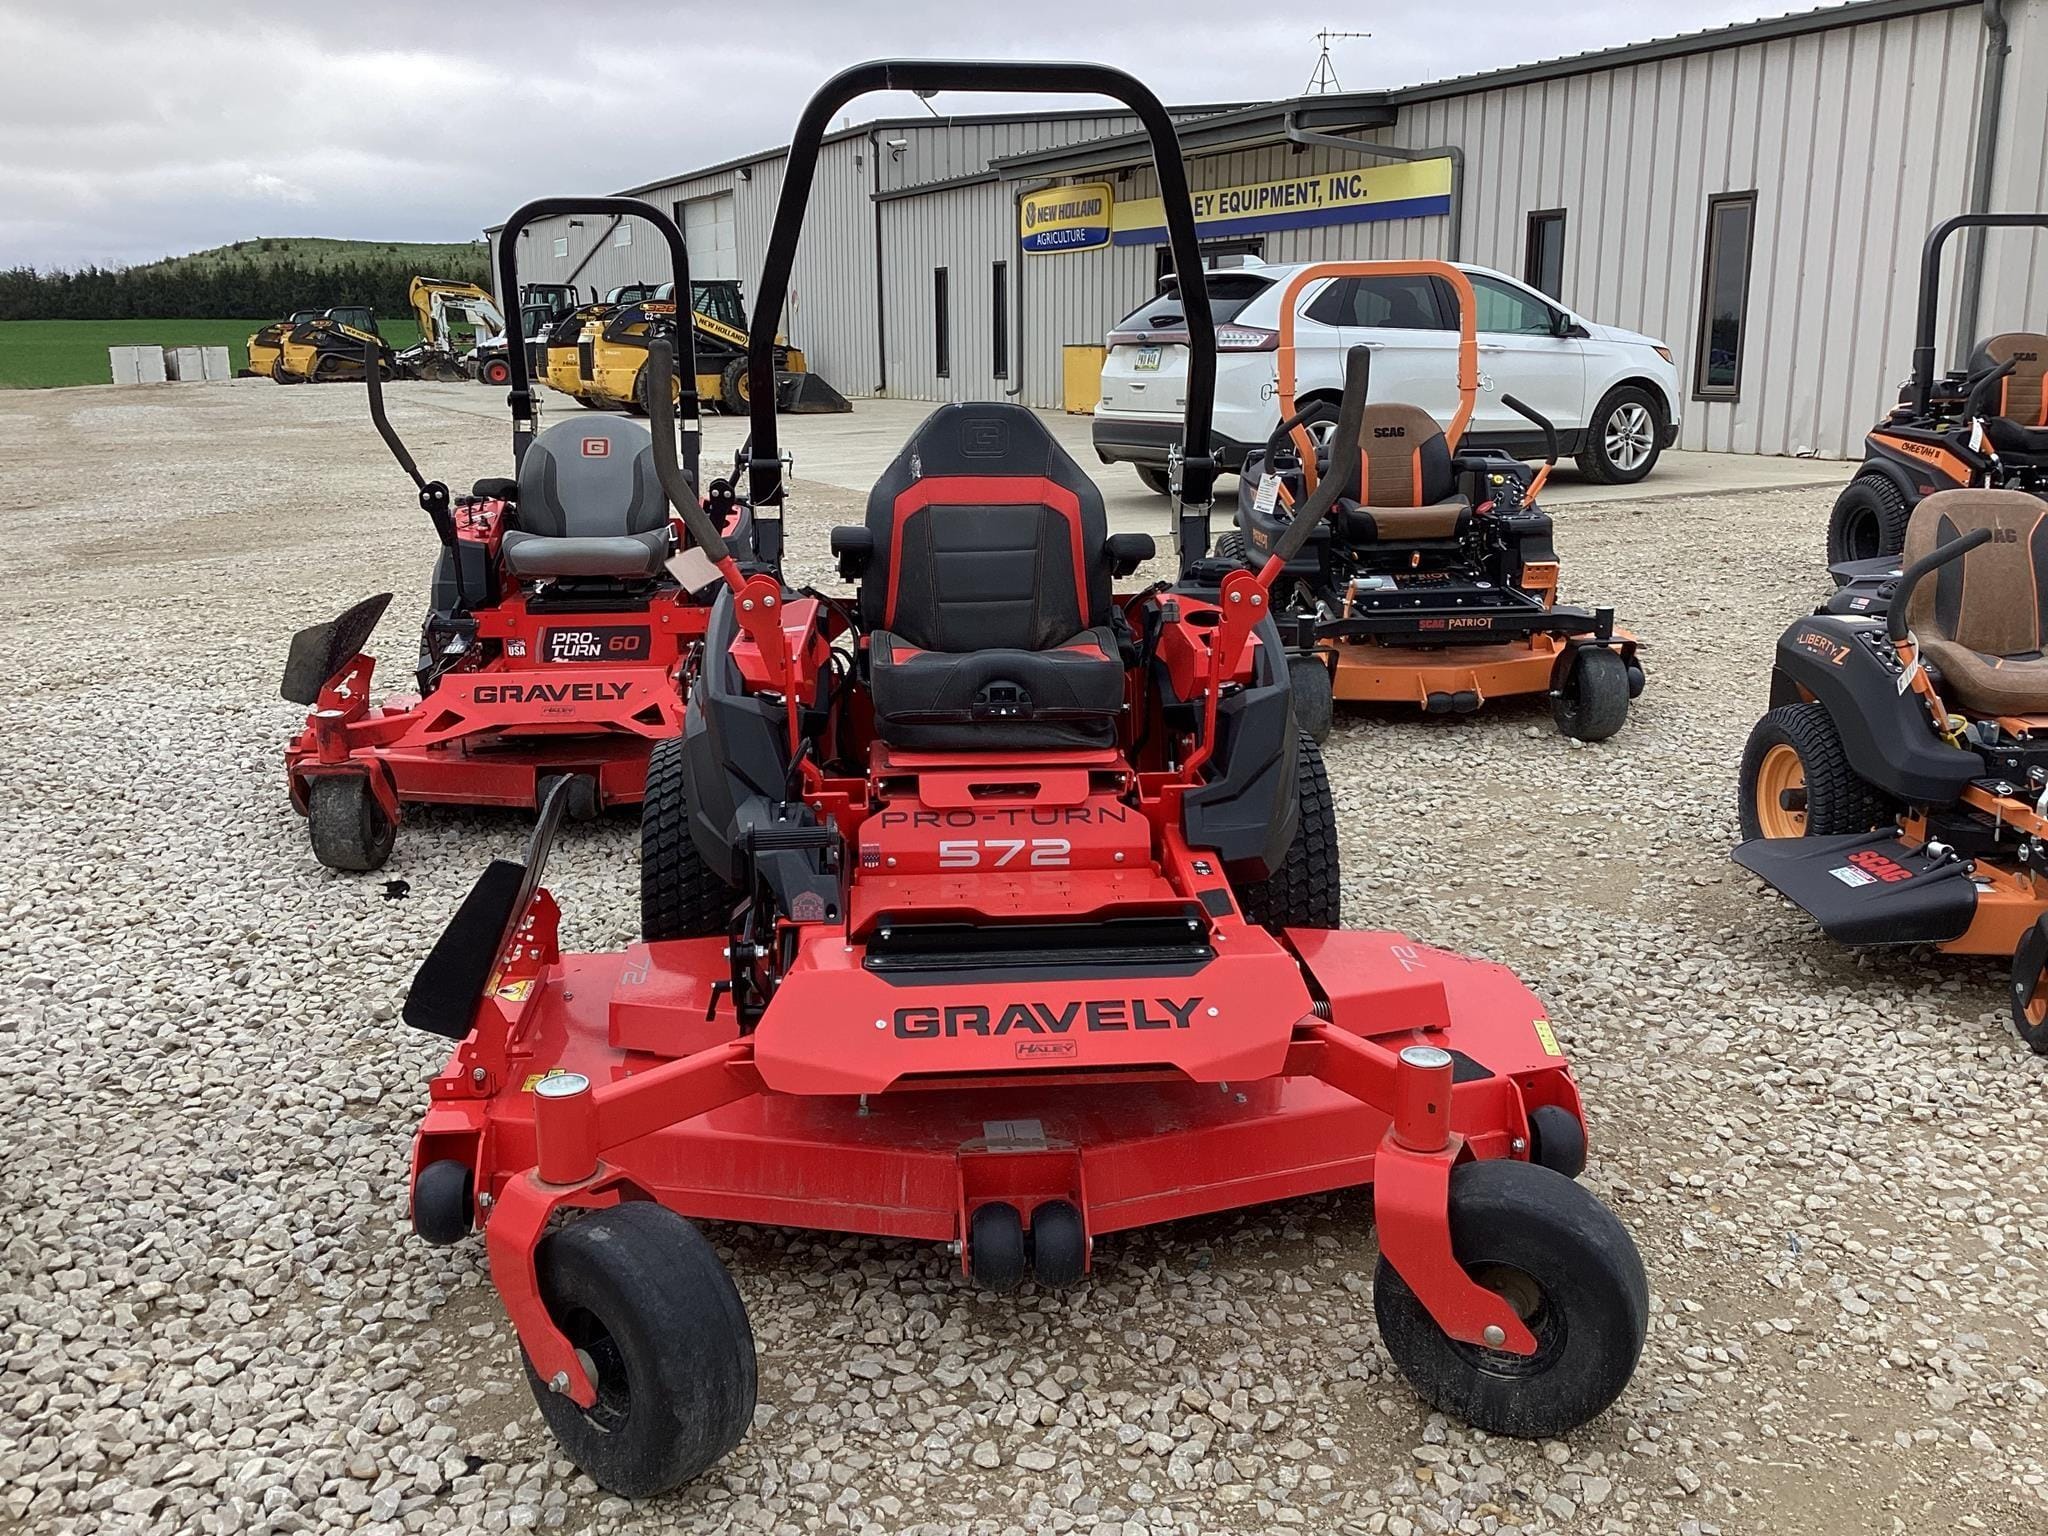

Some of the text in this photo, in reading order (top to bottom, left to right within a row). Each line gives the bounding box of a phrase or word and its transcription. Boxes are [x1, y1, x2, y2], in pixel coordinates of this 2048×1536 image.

[1195, 174, 1367, 217] EY EQUIPMENT, INC.
[1037, 198, 1101, 223] NEW HOLLAND
[1036, 228, 1086, 246] AGRICULTURE
[699, 317, 745, 342] NEW HOLLAND
[1374, 426, 1405, 438] SCAG
[1902, 442, 1934, 458] CHEETAH
[1419, 617, 1493, 630] SCAG PATRIOT
[552, 632, 600, 645] PRO-
[608, 635, 641, 651] 60
[507, 645, 526, 657] USA
[551, 644, 602, 657] TURN
[1798, 633, 1838, 656] LIBERTY
[1831, 645, 1851, 666] Z
[473, 682, 634, 704] GRAVELY
[880, 806, 1127, 829] PRO-TURN
[938, 838, 1072, 868] 572
[1847, 850, 1913, 883] SCAG
[893, 997, 1204, 1039] GRAVELY
[1018, 1043, 1075, 1054] HALEY
